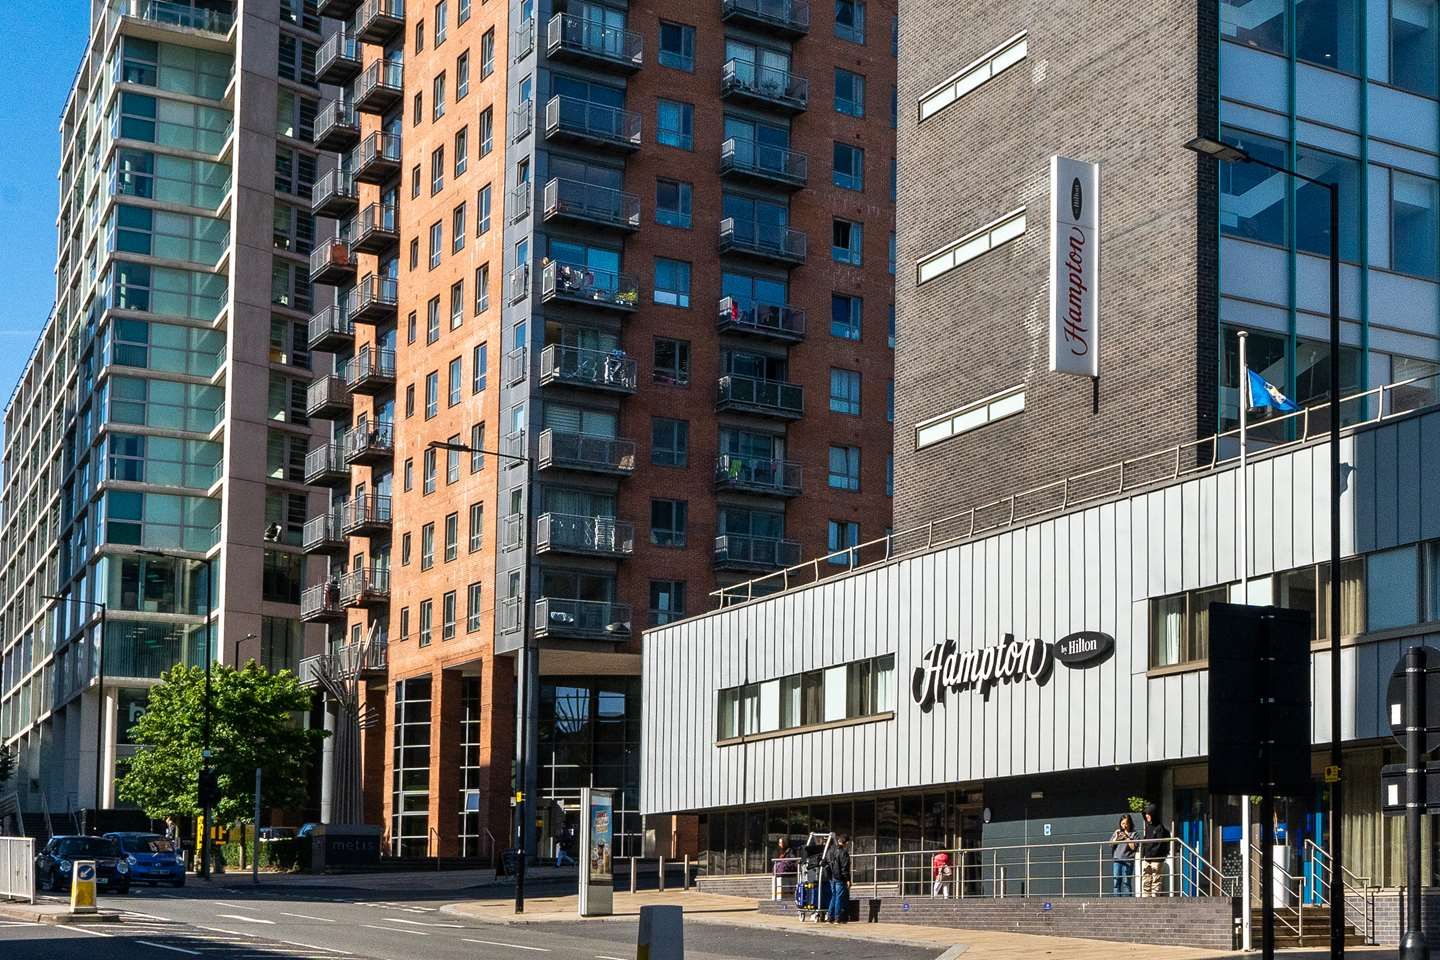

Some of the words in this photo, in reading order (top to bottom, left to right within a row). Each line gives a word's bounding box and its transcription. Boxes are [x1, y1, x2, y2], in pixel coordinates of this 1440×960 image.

[1063, 226, 1088, 356] Hampton
[912, 633, 1047, 705] Hampton
[1068, 638, 1097, 655] Hilton
